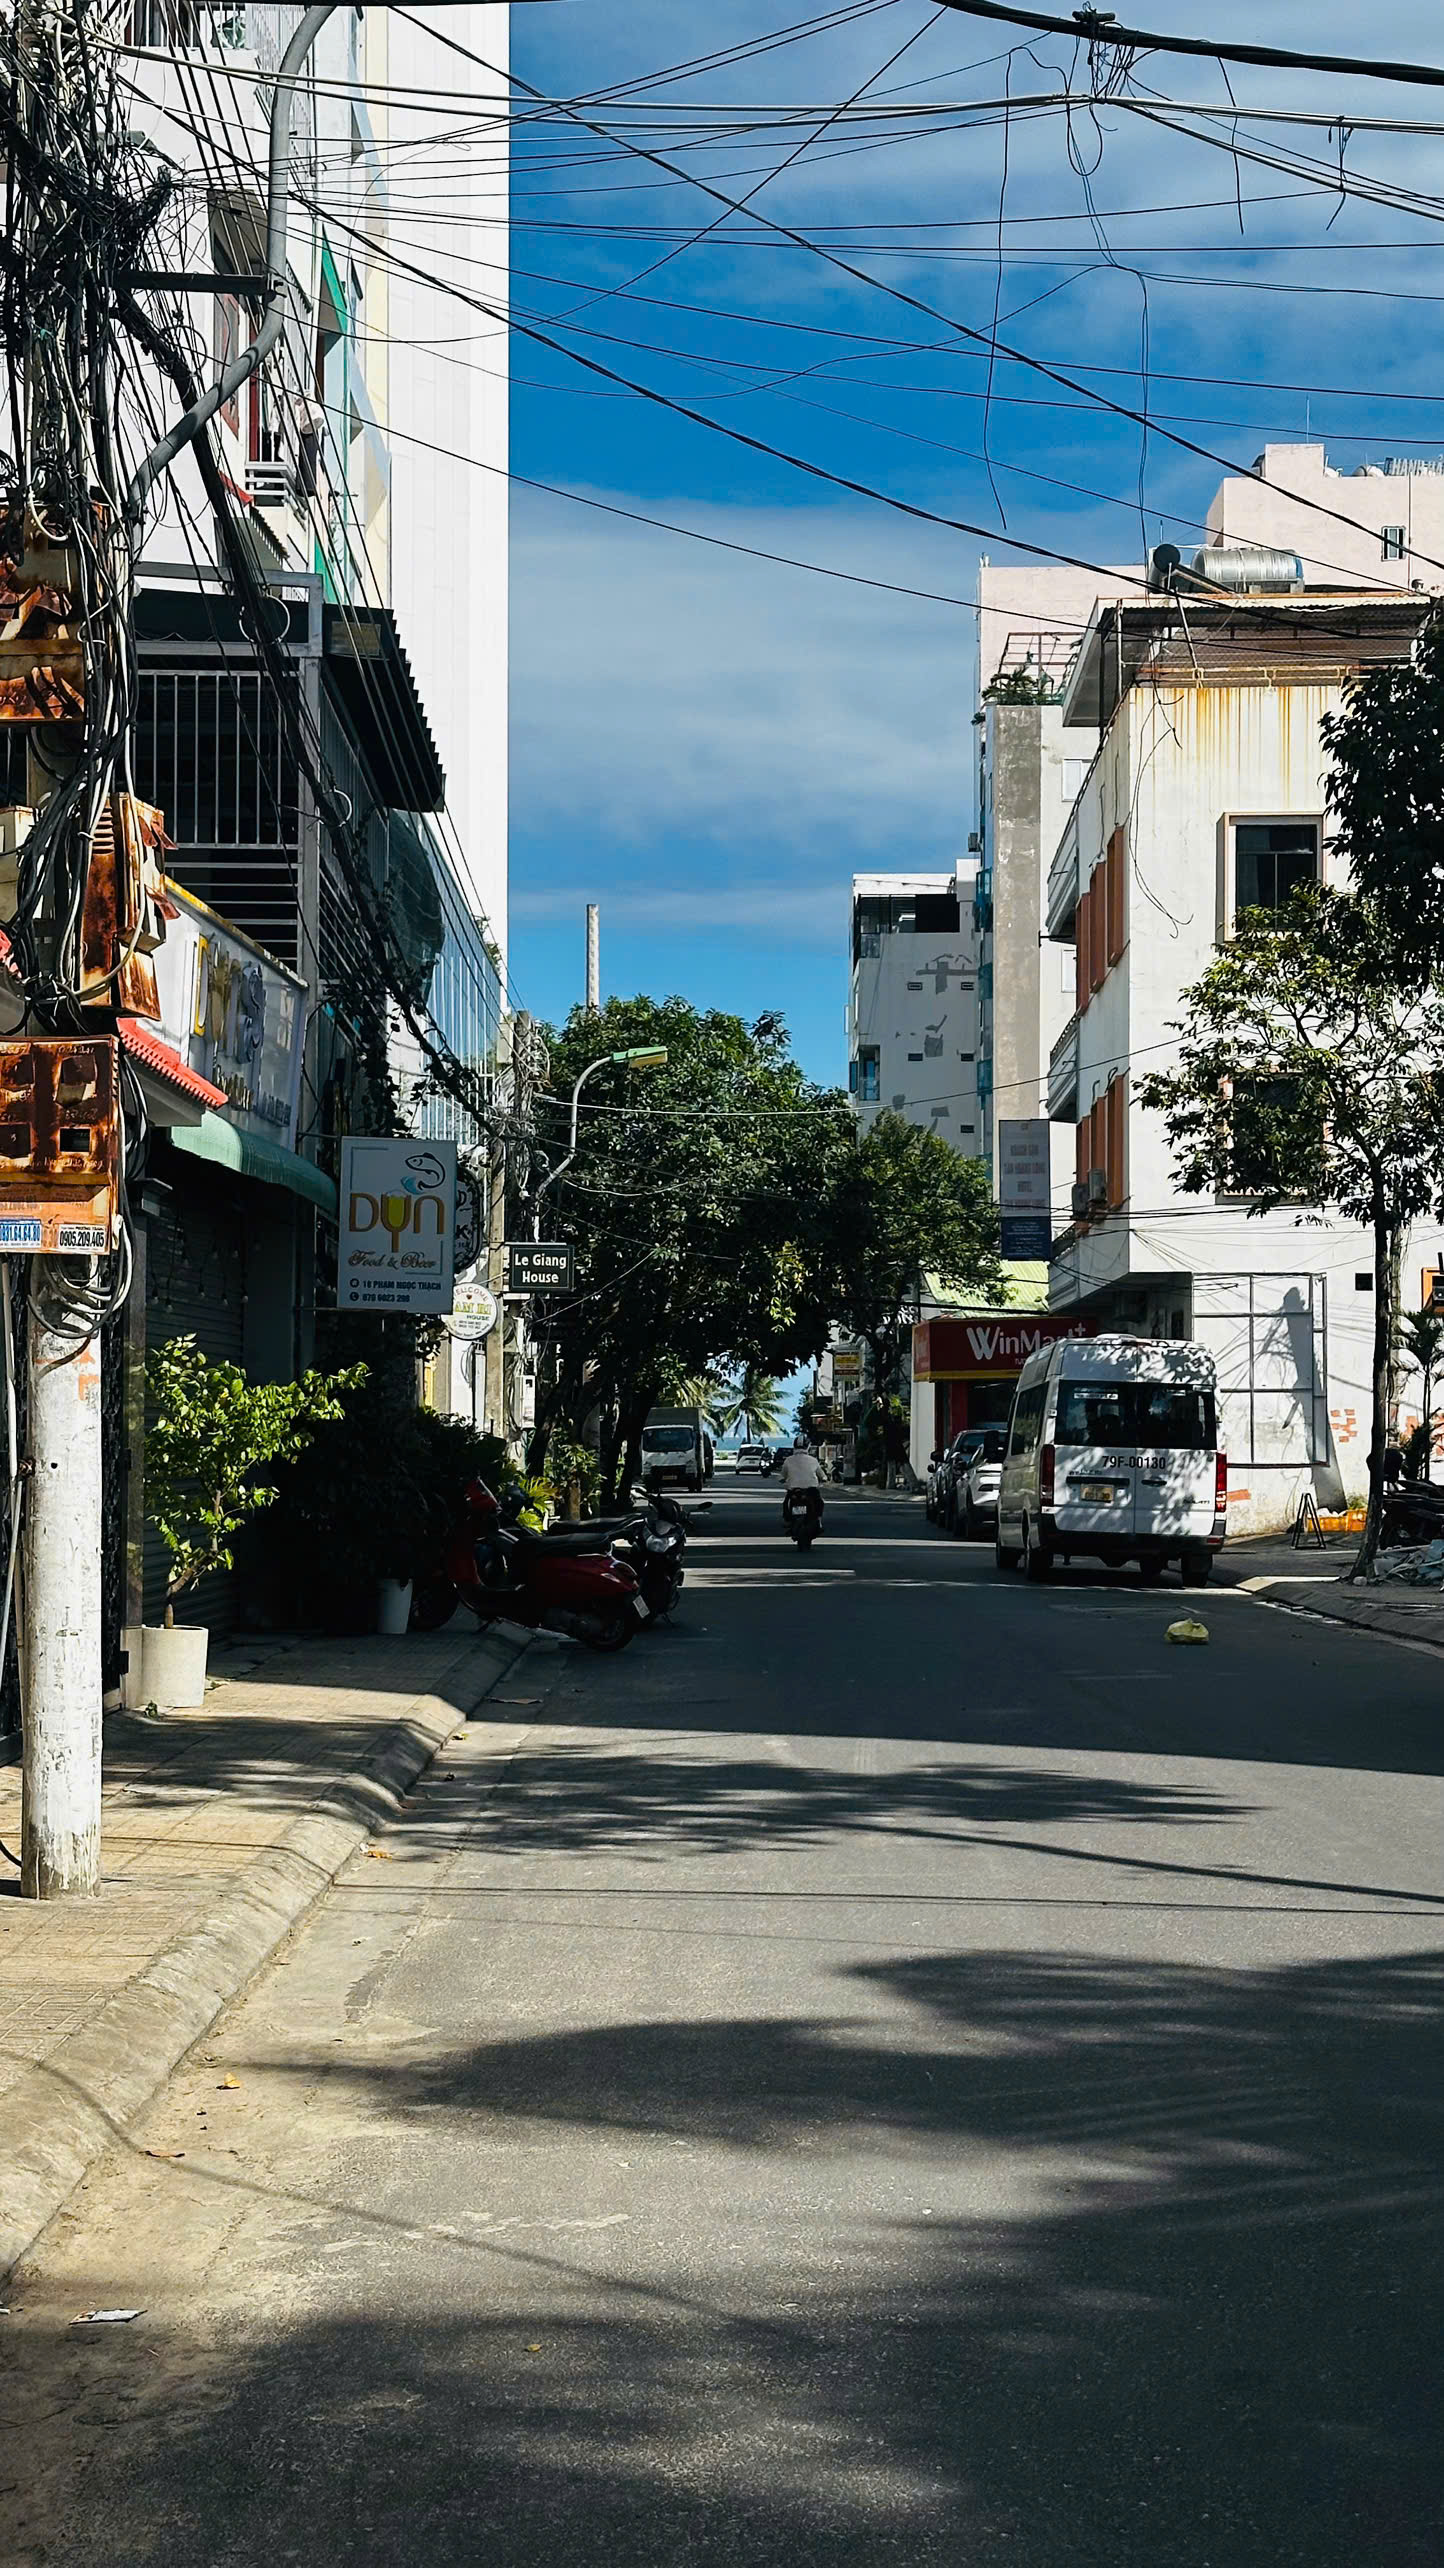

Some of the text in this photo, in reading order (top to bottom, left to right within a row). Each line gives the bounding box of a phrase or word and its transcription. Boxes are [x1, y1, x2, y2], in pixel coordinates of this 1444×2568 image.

[59, 1230, 105, 1247] 0905.209.405
[387, 1256, 399, 1270] &
[401, 1251, 437, 1268] Beer
[514, 1253, 567, 1269] Le Giang
[522, 1271, 559, 1283] House
[966, 1322, 1086, 1361] WinMa+
